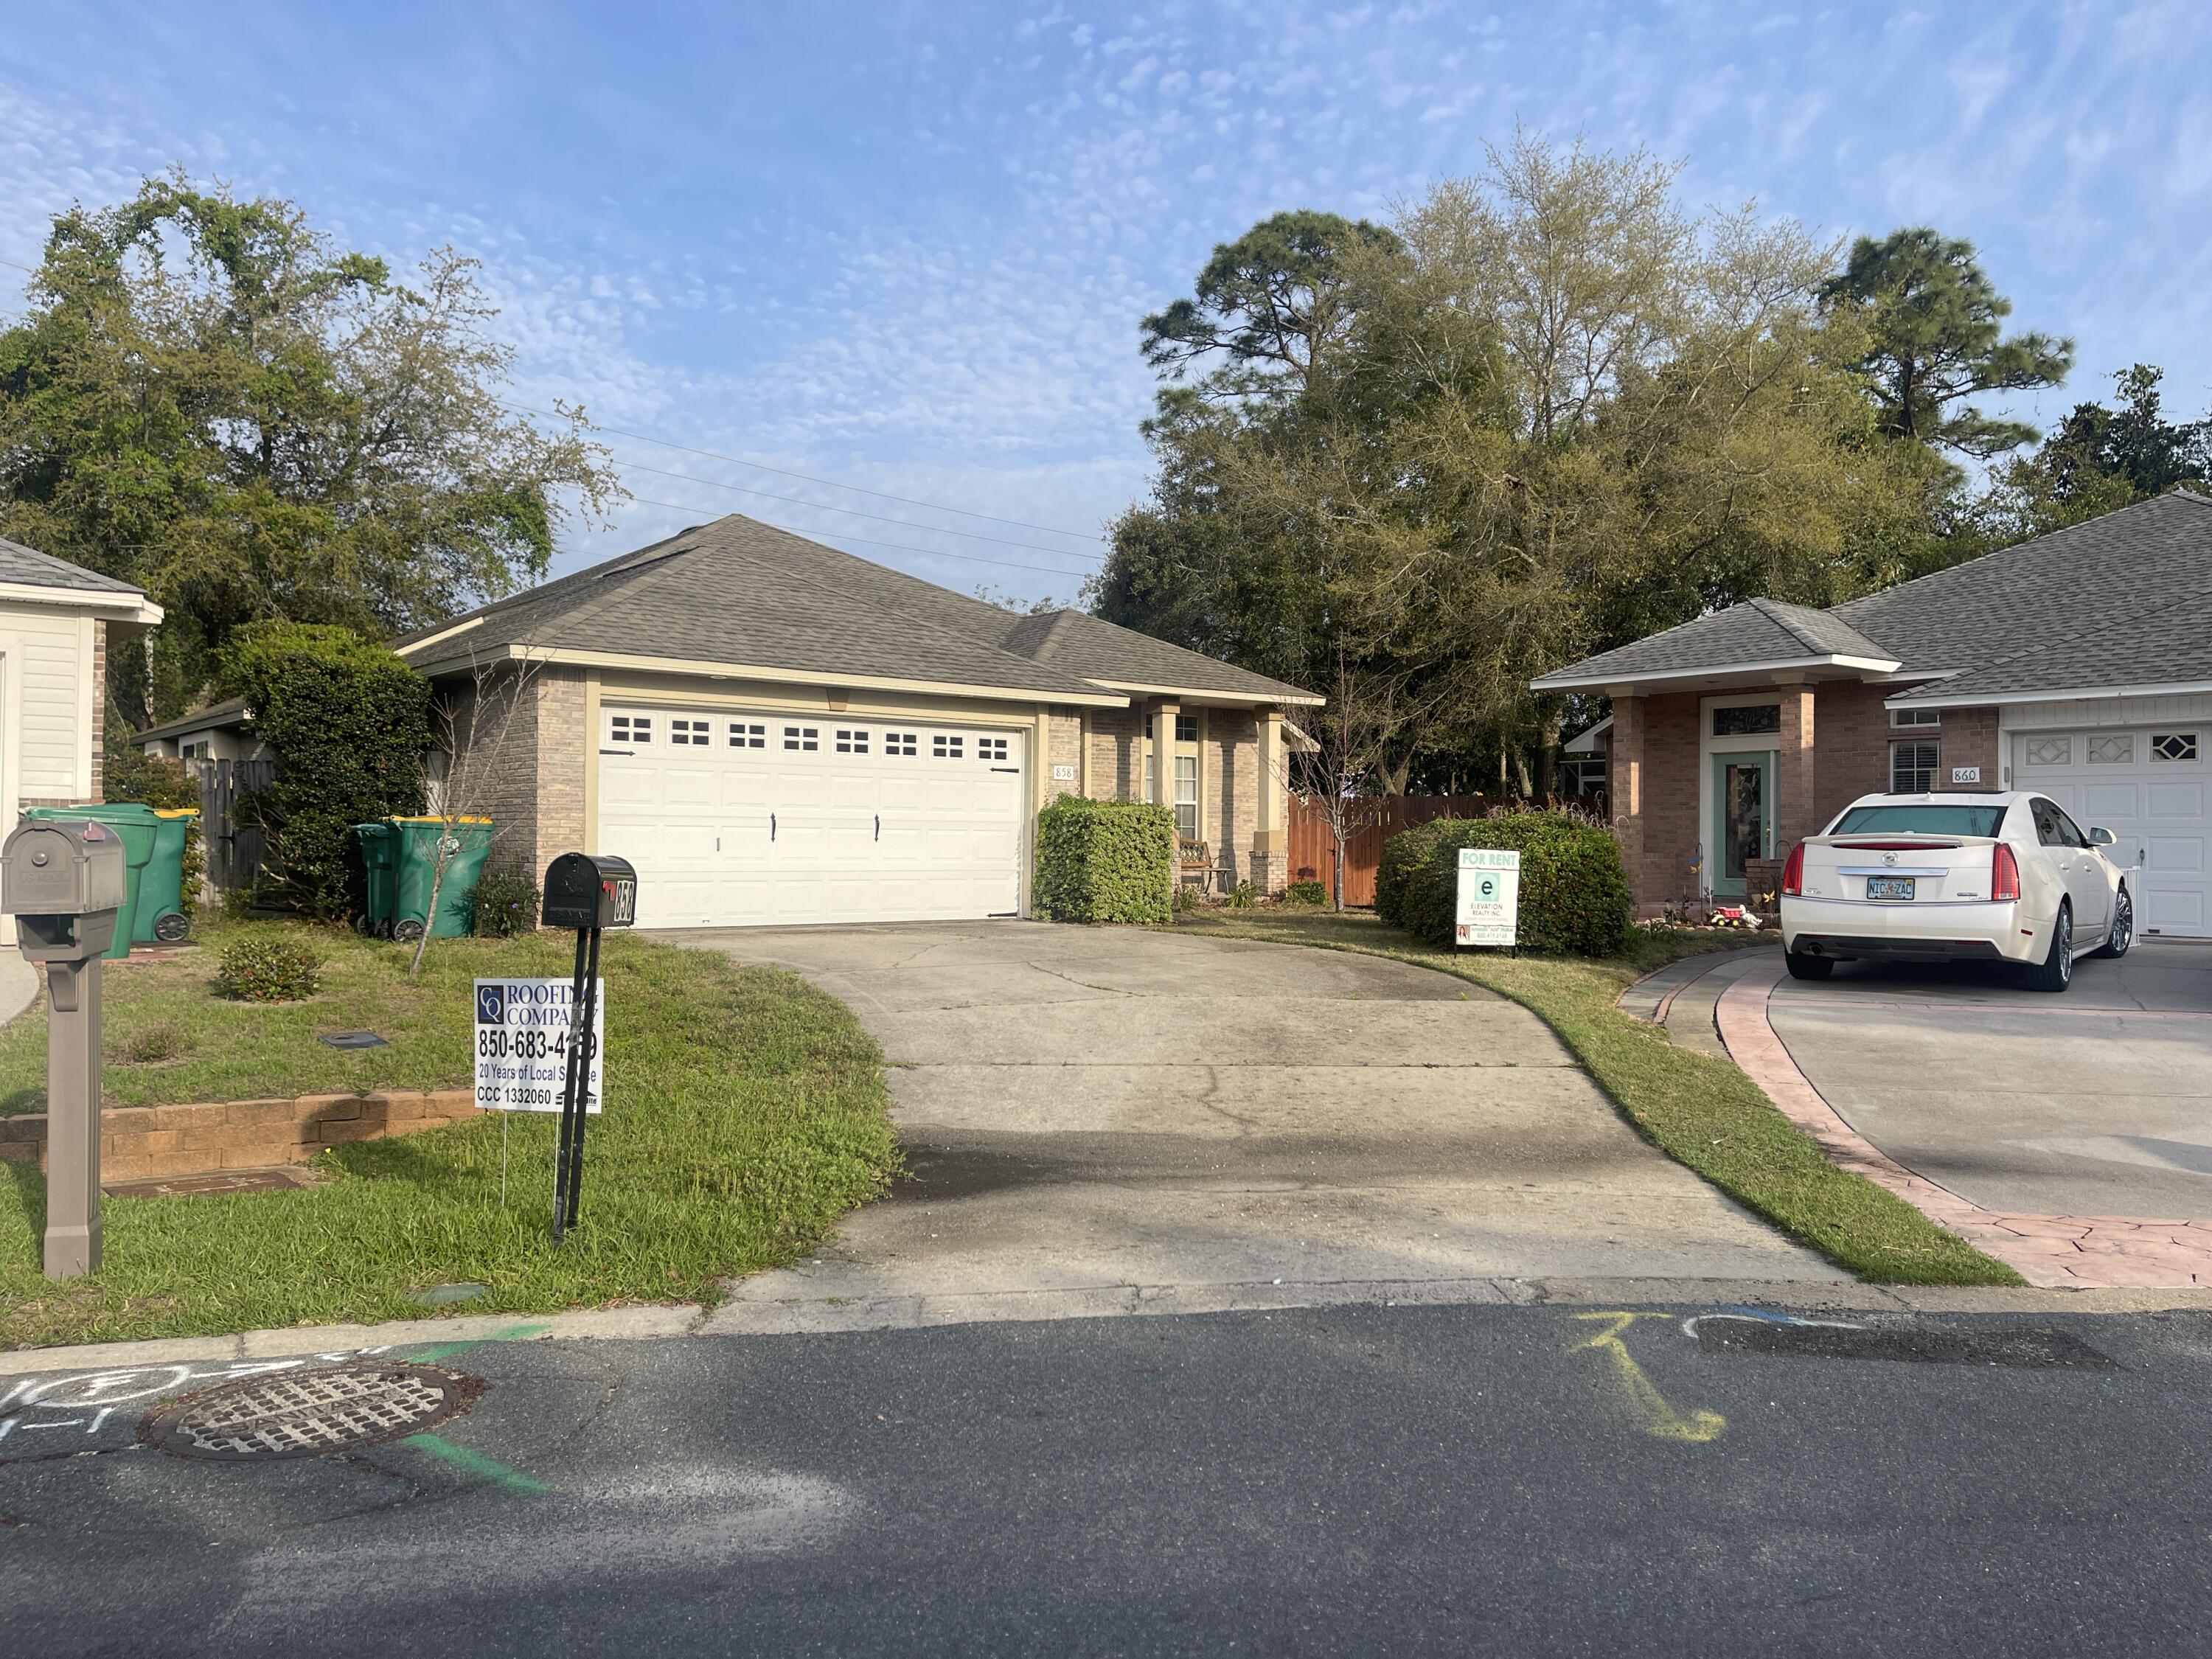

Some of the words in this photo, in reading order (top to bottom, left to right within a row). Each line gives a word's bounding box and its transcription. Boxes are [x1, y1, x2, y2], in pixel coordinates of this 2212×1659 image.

[1056, 767, 1071, 778] 858
[1955, 770, 1976, 781] 860
[1462, 853, 1486, 865] FOR
[1489, 854, 1517, 866] RENT
[615, 881, 633, 920] 858
[479, 1062, 489, 1078] 20
[491, 1063, 515, 1080] Years
[518, 1065, 528, 1080] of
[530, 1065, 555, 1082] Local
[478, 1086, 501, 1102] CCC
[505, 1088, 551, 1105] 1332060
